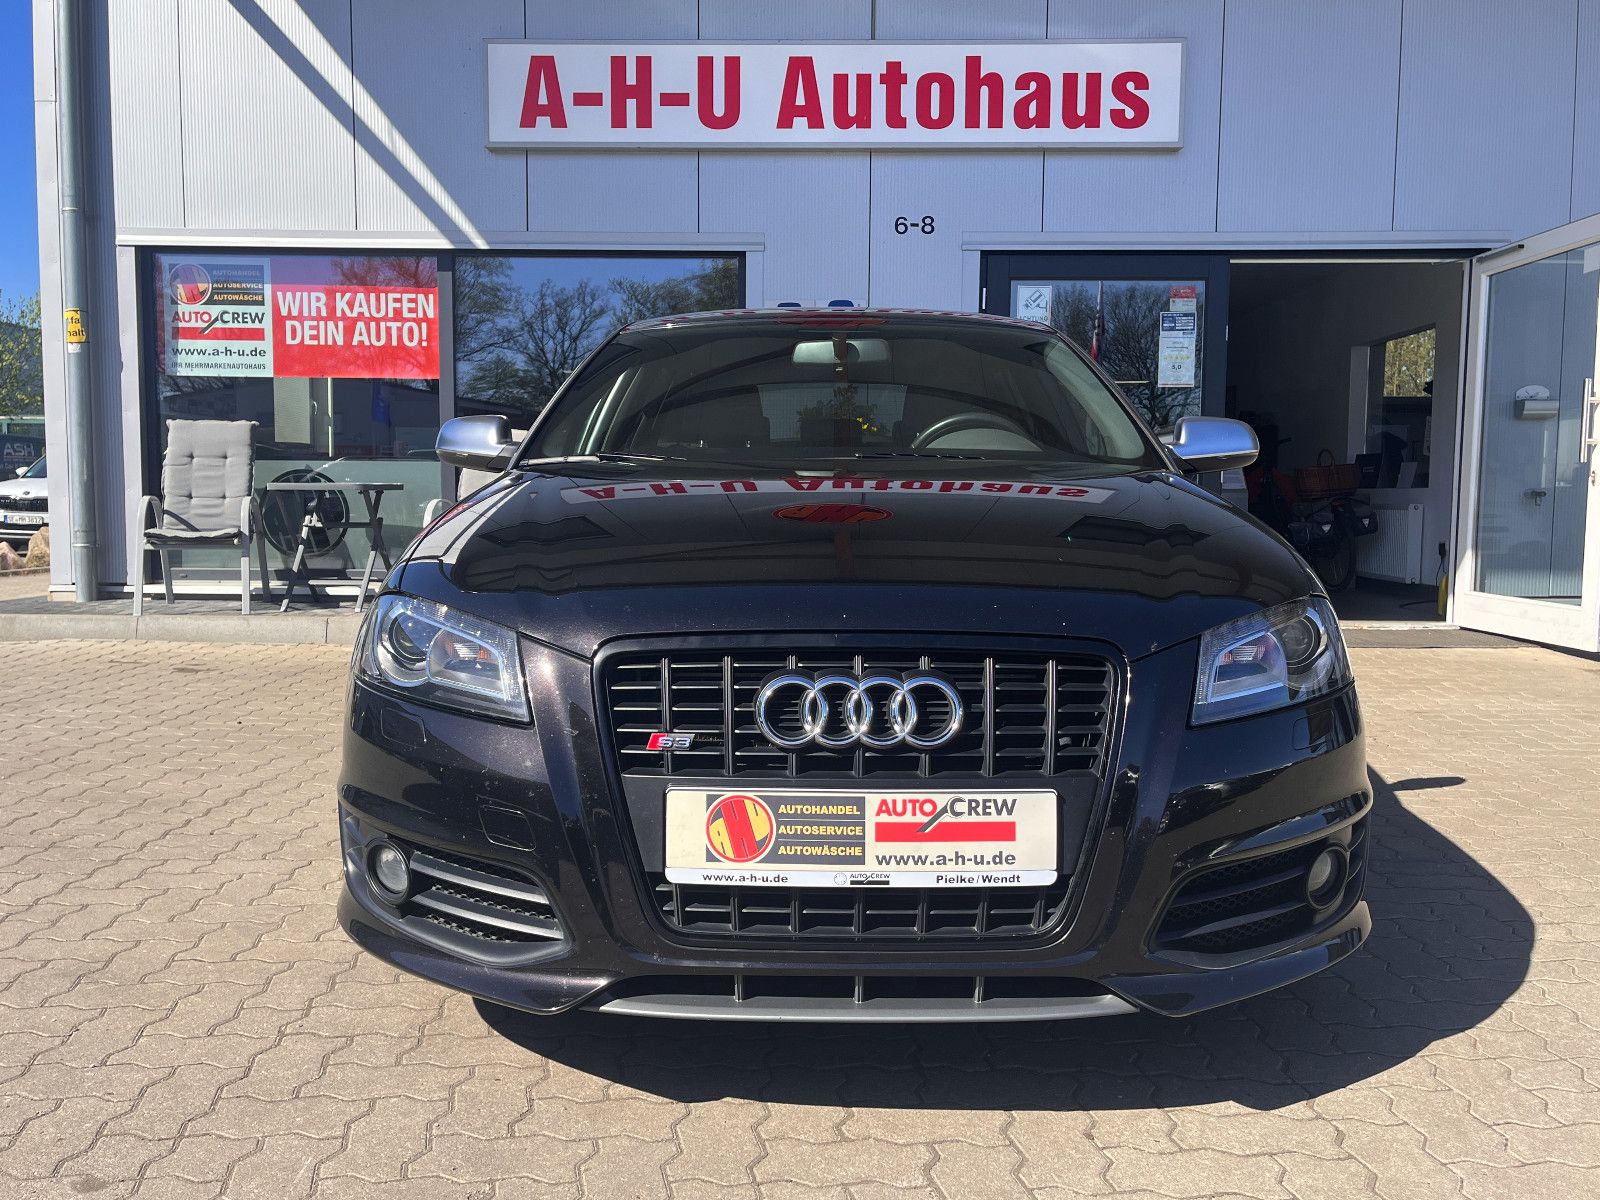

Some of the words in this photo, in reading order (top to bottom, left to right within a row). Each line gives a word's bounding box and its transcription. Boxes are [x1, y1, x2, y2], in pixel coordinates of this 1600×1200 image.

[519, 55, 741, 130] A-H-U
[776, 55, 1150, 130] Autohaus
[894, 215, 936, 236] 6-8
[213, 293, 263, 301] AUTOWÄSCHE
[276, 291, 327, 317] WIR
[335, 292, 434, 319] KAUFEN
[285, 320, 344, 346] DEIN
[352, 321, 428, 347] AUTO!
[171, 346, 267, 357] www.a-h-u.de
[184, 362, 266, 370] MEHRMARKENAUTOHAUS
[655, 736, 692, 749] S3
[778, 804, 860, 815] AUTOHANDEL
[778, 825, 863, 836] AUTOSERVICE
[778, 844, 863, 856] AUTOWÄSCHE
[875, 851, 1016, 866] www.a-h-u.de
[702, 872, 789, 884] www.a-h-u.de
[936, 874, 1021, 884] Pielke/Wendt
